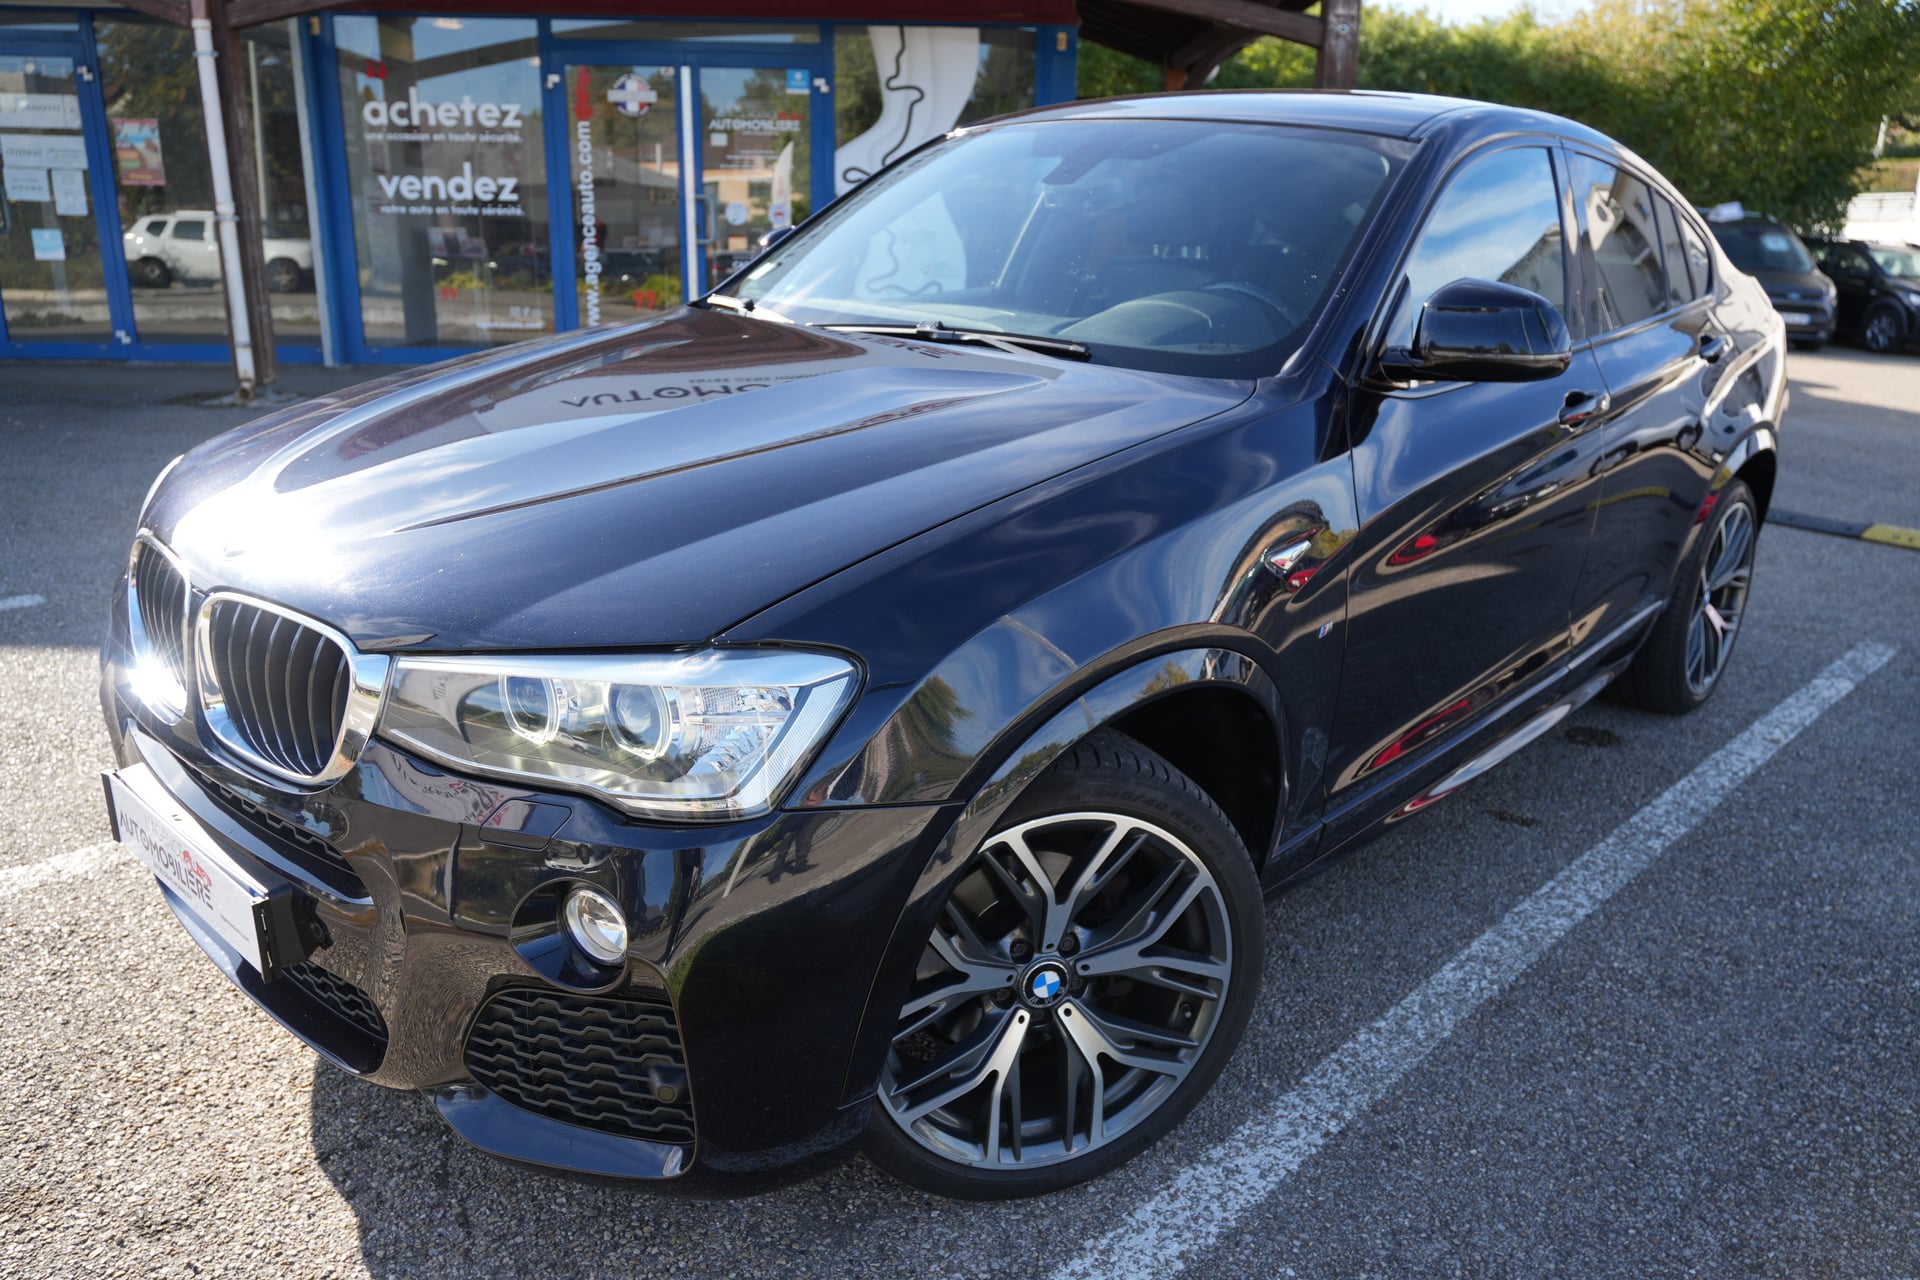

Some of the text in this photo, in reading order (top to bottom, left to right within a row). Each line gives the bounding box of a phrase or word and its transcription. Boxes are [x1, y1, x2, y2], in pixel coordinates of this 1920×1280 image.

[362, 86, 523, 128] achetez
[377, 161, 519, 201] vendez
[576, 120, 602, 327] www.agenceauto.com
